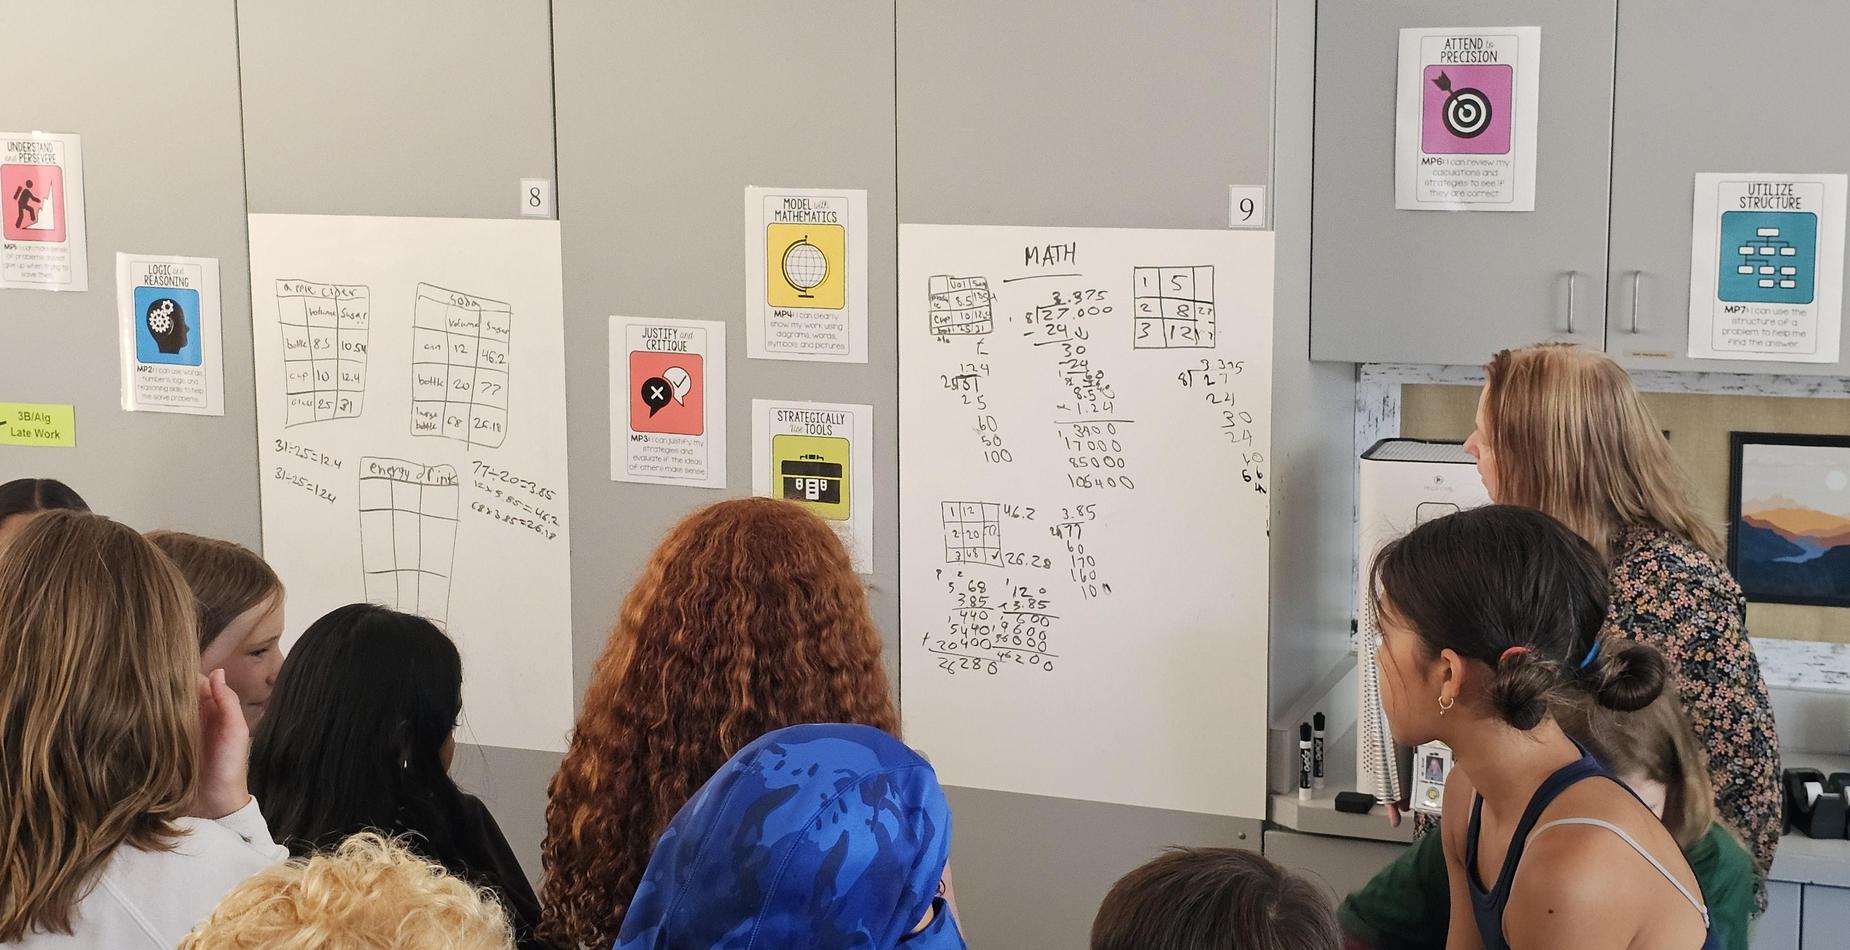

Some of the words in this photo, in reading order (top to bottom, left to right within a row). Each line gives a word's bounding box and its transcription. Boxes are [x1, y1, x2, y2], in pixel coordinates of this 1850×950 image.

[1444, 37, 1483, 50] ATTEND
[1440, 50, 1498, 63] PRECISION
[7, 141, 54, 152] UNDERSTAND
[19, 152, 56, 164] PERSEVERE
[1496, 160, 1512, 168] my
[1425, 180, 1469, 188] strategies
[1748, 183, 1794, 196] UTILIZE
[529, 186, 541, 207] 8
[1429, 190, 1450, 198] they
[783, 198, 812, 210] MODEL
[1239, 197, 1254, 222] 9
[1739, 196, 1802, 210] STRUCTURE
[774, 210, 838, 223] MATHEMATICS
[1024, 241, 1077, 267] MATH
[148, 263, 171, 276] LOGIC
[144, 274, 189, 288] REASONING
[1171, 274, 1188, 291] 5
[813, 312, 839, 321] clearly
[1140, 303, 1152, 313] 2
[1176, 304, 1189, 318] 8
[1791, 308, 1807, 316] the
[824, 323, 844, 331] using
[1731, 318, 1776, 326] structure
[642, 327, 678, 340] JUSTIFY
[1137, 322, 1151, 339] 3
[1170, 325, 1194, 341] 12
[1722, 328, 1759, 336] problem
[1762, 328, 1771, 336] to
[1772, 329, 1790, 338] help
[646, 338, 688, 352] CRITIQUE
[800, 341, 814, 349] and
[1727, 338, 1746, 346] find
[454, 343, 468, 354] 12
[481, 349, 506, 364] 46.2
[1061, 343, 1086, 358] 30
[316, 369, 330, 382] 10
[342, 372, 360, 384] 12.4
[453, 378, 470, 391] 20
[480, 381, 501, 396] 77
[318, 399, 333, 410] 25
[18, 411, 51, 425] 3B/Alg
[777, 409, 846, 425] STRATEGICALLY
[977, 415, 998, 432] 60
[1220, 410, 1252, 428] 30
[10, 427, 32, 438] Late
[34, 428, 61, 439] Work
[804, 423, 833, 436] TOOLS
[668, 438, 692, 446] justify
[981, 434, 1002, 447] 50
[642, 446, 679, 454] strategies
[984, 449, 1013, 464] 100
[671, 456, 683, 464] the
[639, 464, 663, 472] others
[963, 506, 975, 517] 12
[1003, 504, 1037, 521] 46.2
[1062, 503, 1097, 520] 3.85
[966, 529, 980, 540] 20
[968, 580, 986, 593] 68
